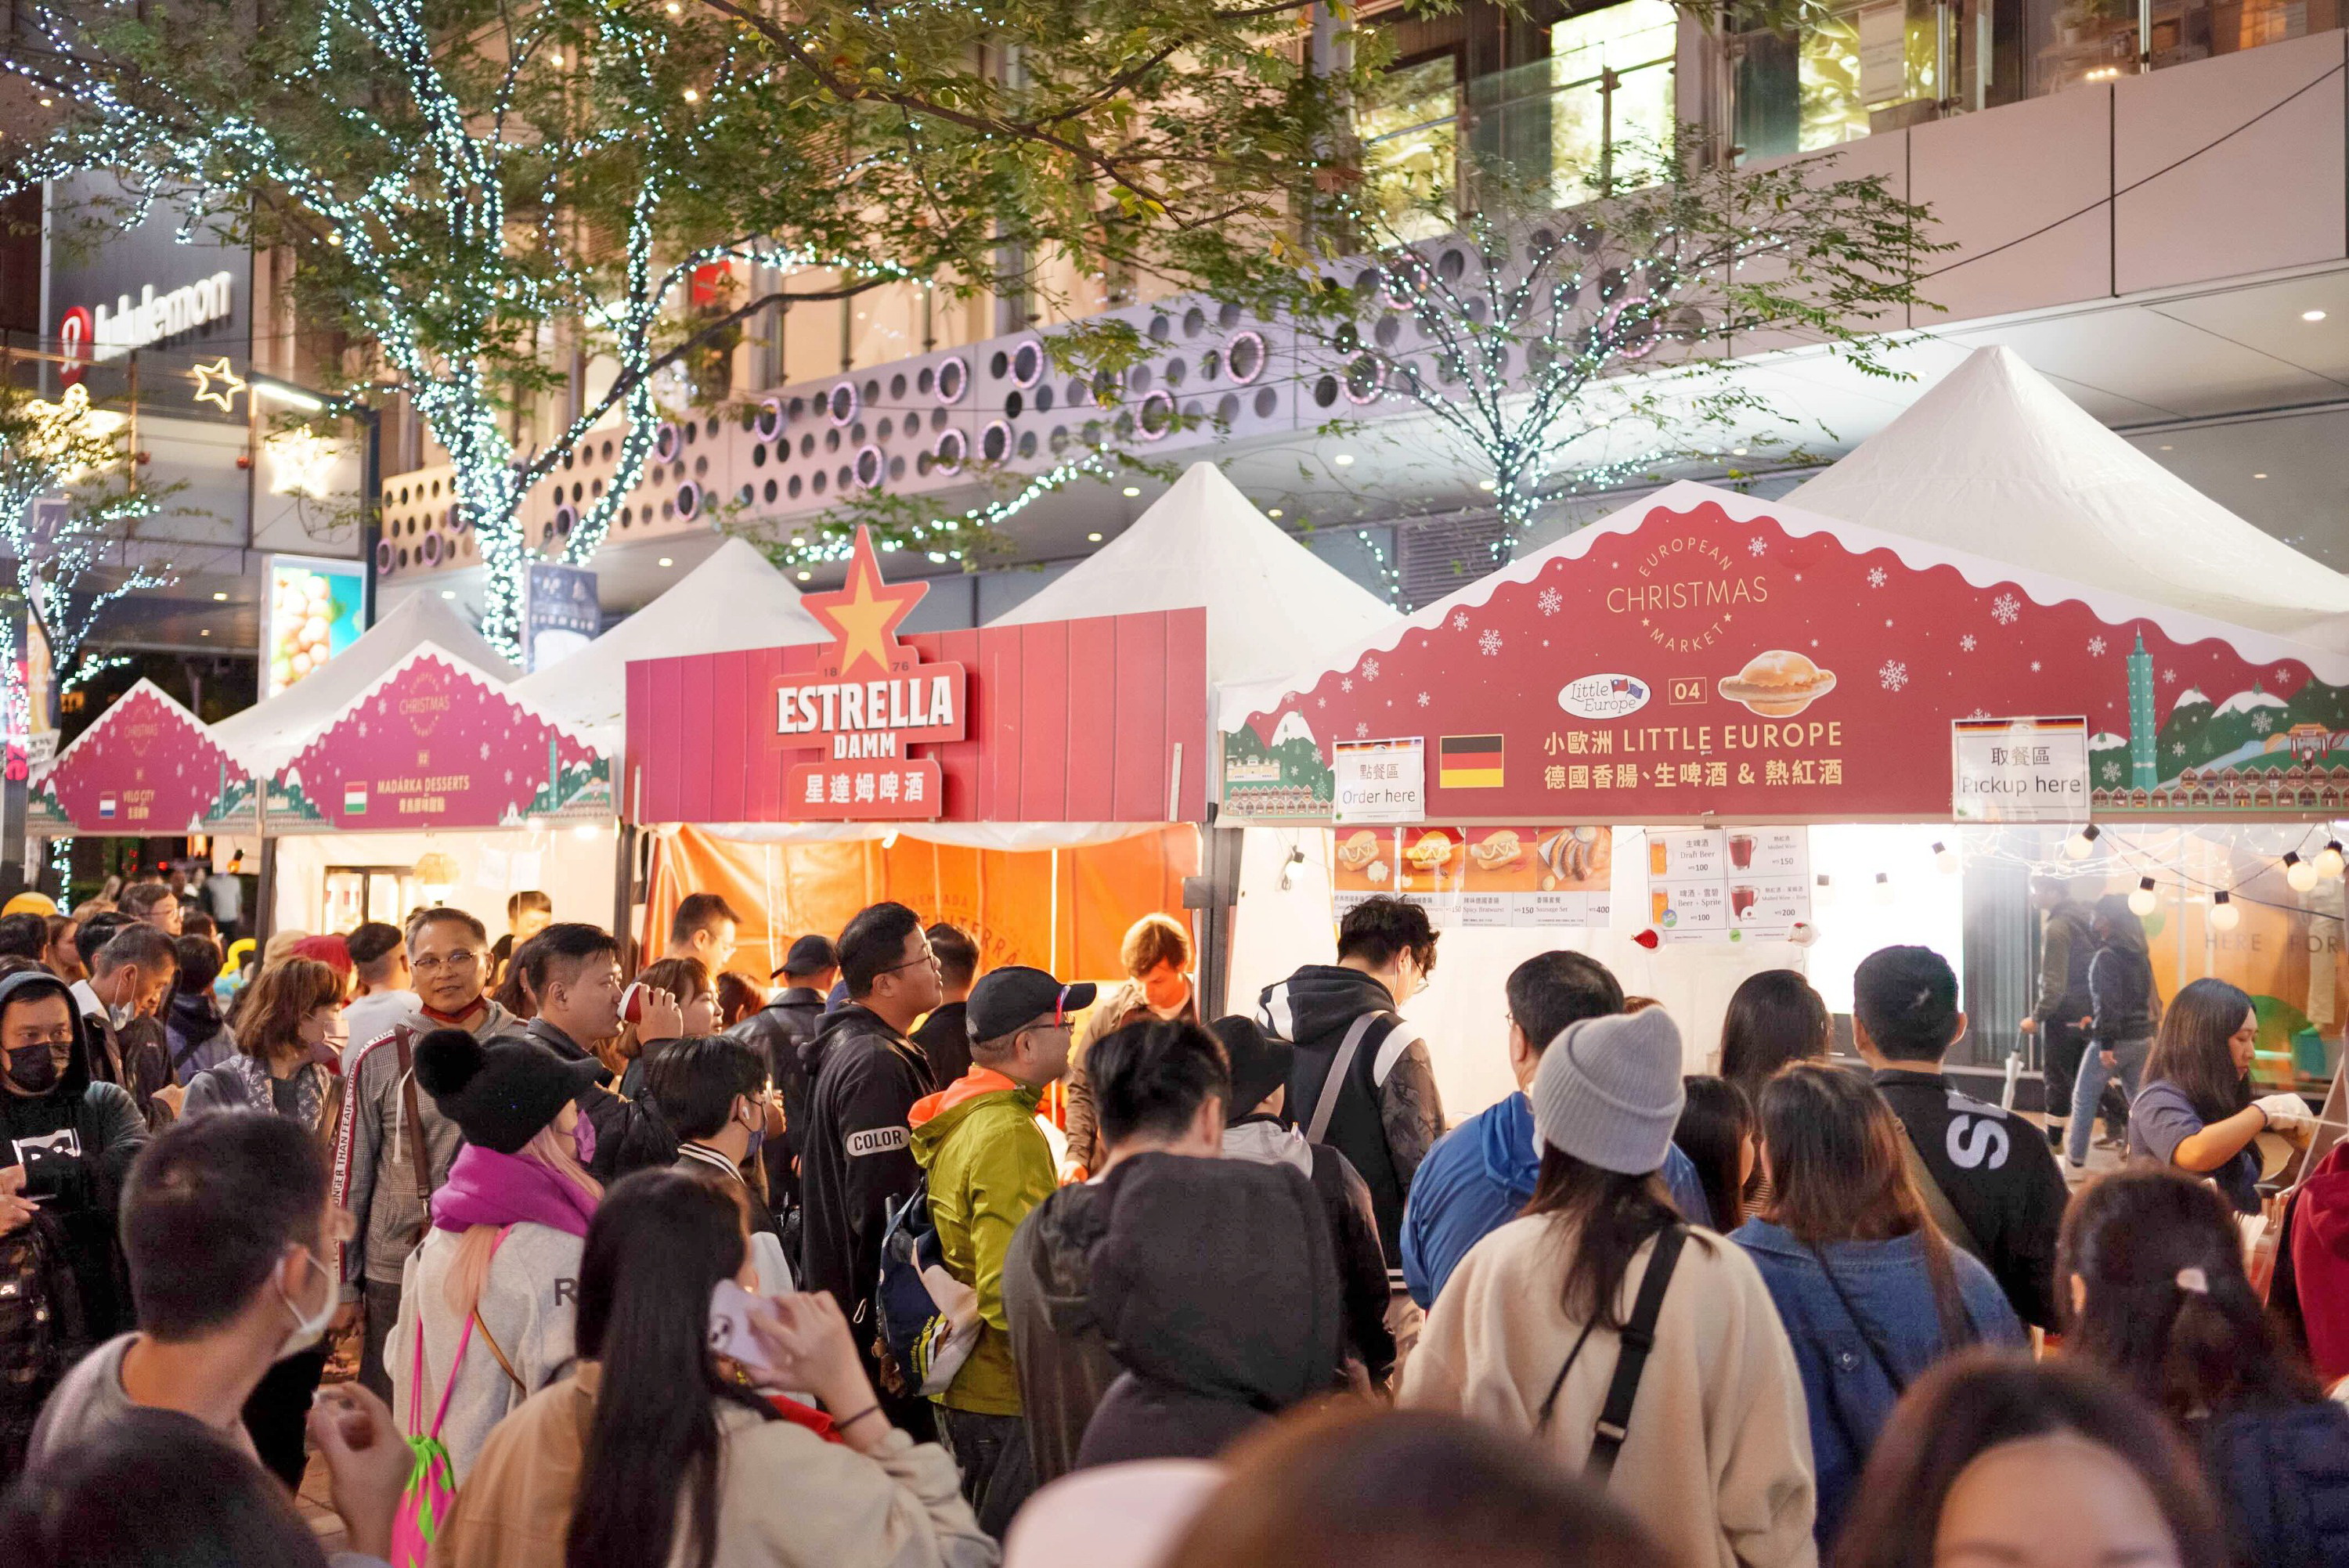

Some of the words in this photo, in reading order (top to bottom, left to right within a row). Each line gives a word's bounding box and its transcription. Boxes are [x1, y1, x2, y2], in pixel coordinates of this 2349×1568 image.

[1639, 537, 1733, 577] EUROPEAN
[1607, 576, 1768, 613] CHRISTMAS
[1650, 622, 1723, 653] MARKET
[824, 668, 838, 677] 18
[893, 662, 909, 672] 76
[1570, 682, 1609, 702] Little
[1674, 682, 1701, 700] 04
[399, 694, 450, 716] CHRISTMAS
[778, 676, 954, 734] ESTRELLA
[1584, 698, 1636, 714] Europe
[833, 732, 896, 759] DAMM
[1543, 730, 1613, 756] 小歐洲
[1623, 726, 1712, 753] LITTLE
[1724, 722, 1842, 749] EUROPE
[1991, 746, 2051, 766] 取餐區
[1359, 763, 1399, 780] 點餐區
[1737, 762, 1755, 785] &
[1765, 759, 1843, 787] 熱紅酒
[377, 776, 423, 794] MADÁRKA
[424, 775, 470, 793] DESSERTS
[805, 771, 924, 804] 星達姆啤酒
[1962, 775, 2027, 797] Pickup
[2036, 775, 2080, 793] here
[1342, 789, 1380, 805] Order
[1385, 788, 1416, 803] here
[1701, 899, 1722, 907] Sprite
[2206, 934, 2262, 952] HERE
[341, 1101, 352, 1134] FEAR.
[337, 1135, 348, 1166] THAN
[854, 1130, 902, 1151] COLOR
